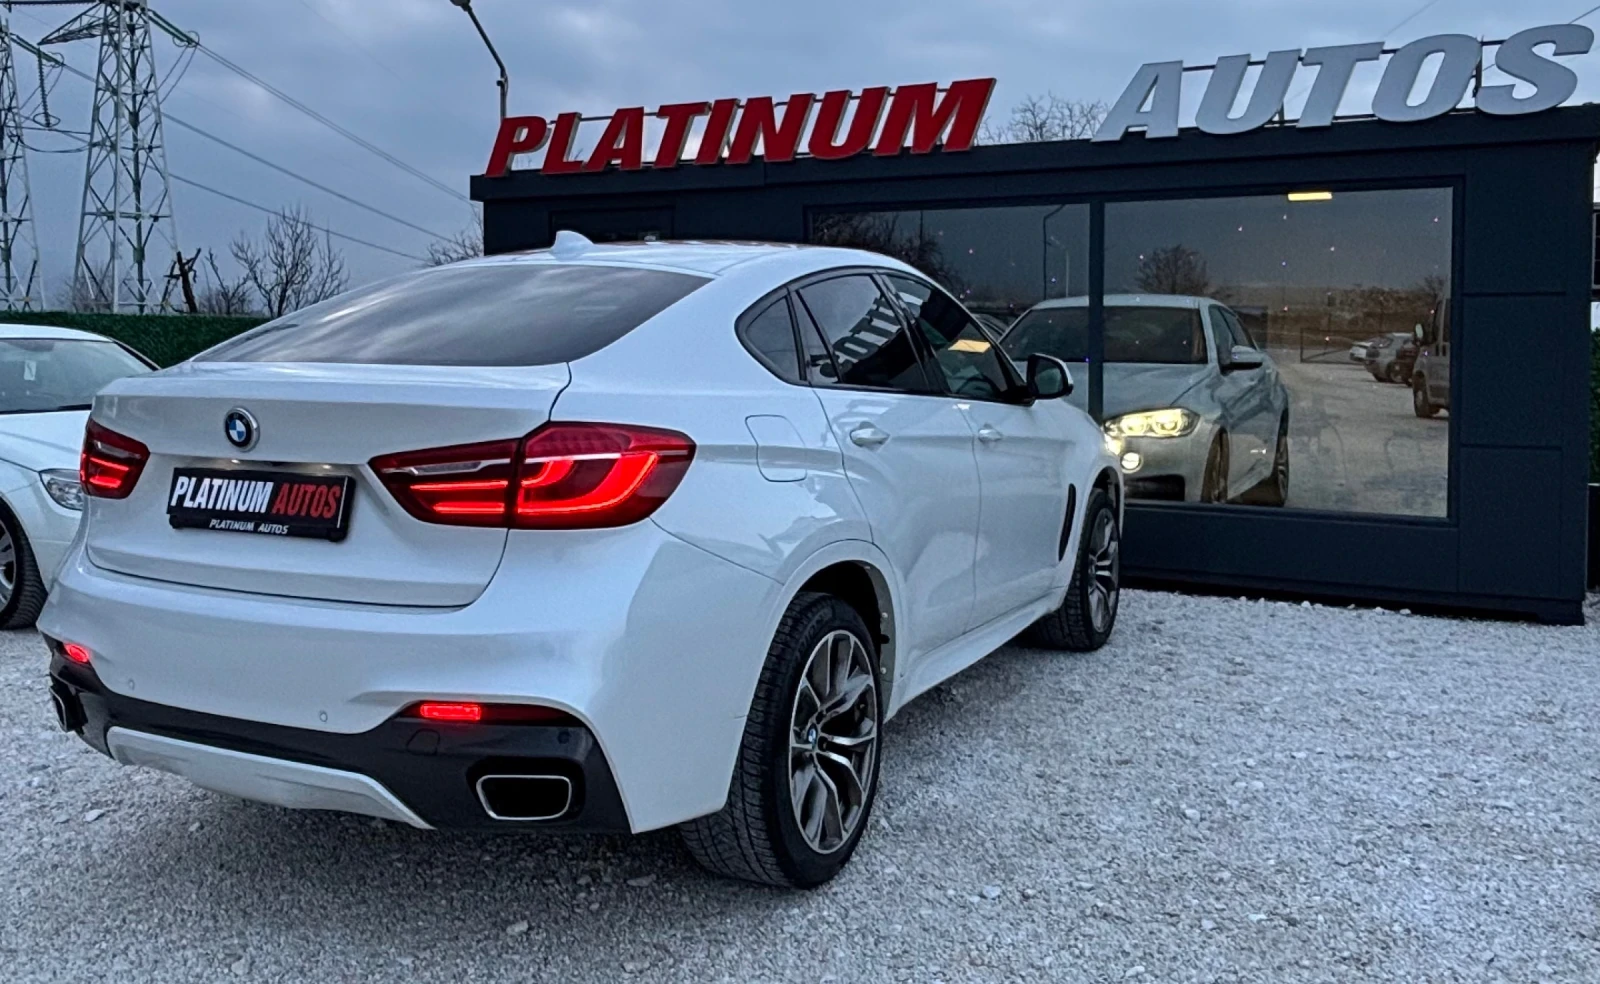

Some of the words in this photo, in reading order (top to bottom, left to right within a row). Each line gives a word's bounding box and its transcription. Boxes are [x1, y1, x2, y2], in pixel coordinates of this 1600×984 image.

[485, 78, 996, 177] PLATINUM
[1090, 24, 1594, 142] AUTOS
[170, 476, 274, 513] PLATINUM
[272, 482, 341, 518] AUTOS
[209, 519, 255, 531] PLATINUM
[257, 523, 289, 534] AUTOS
